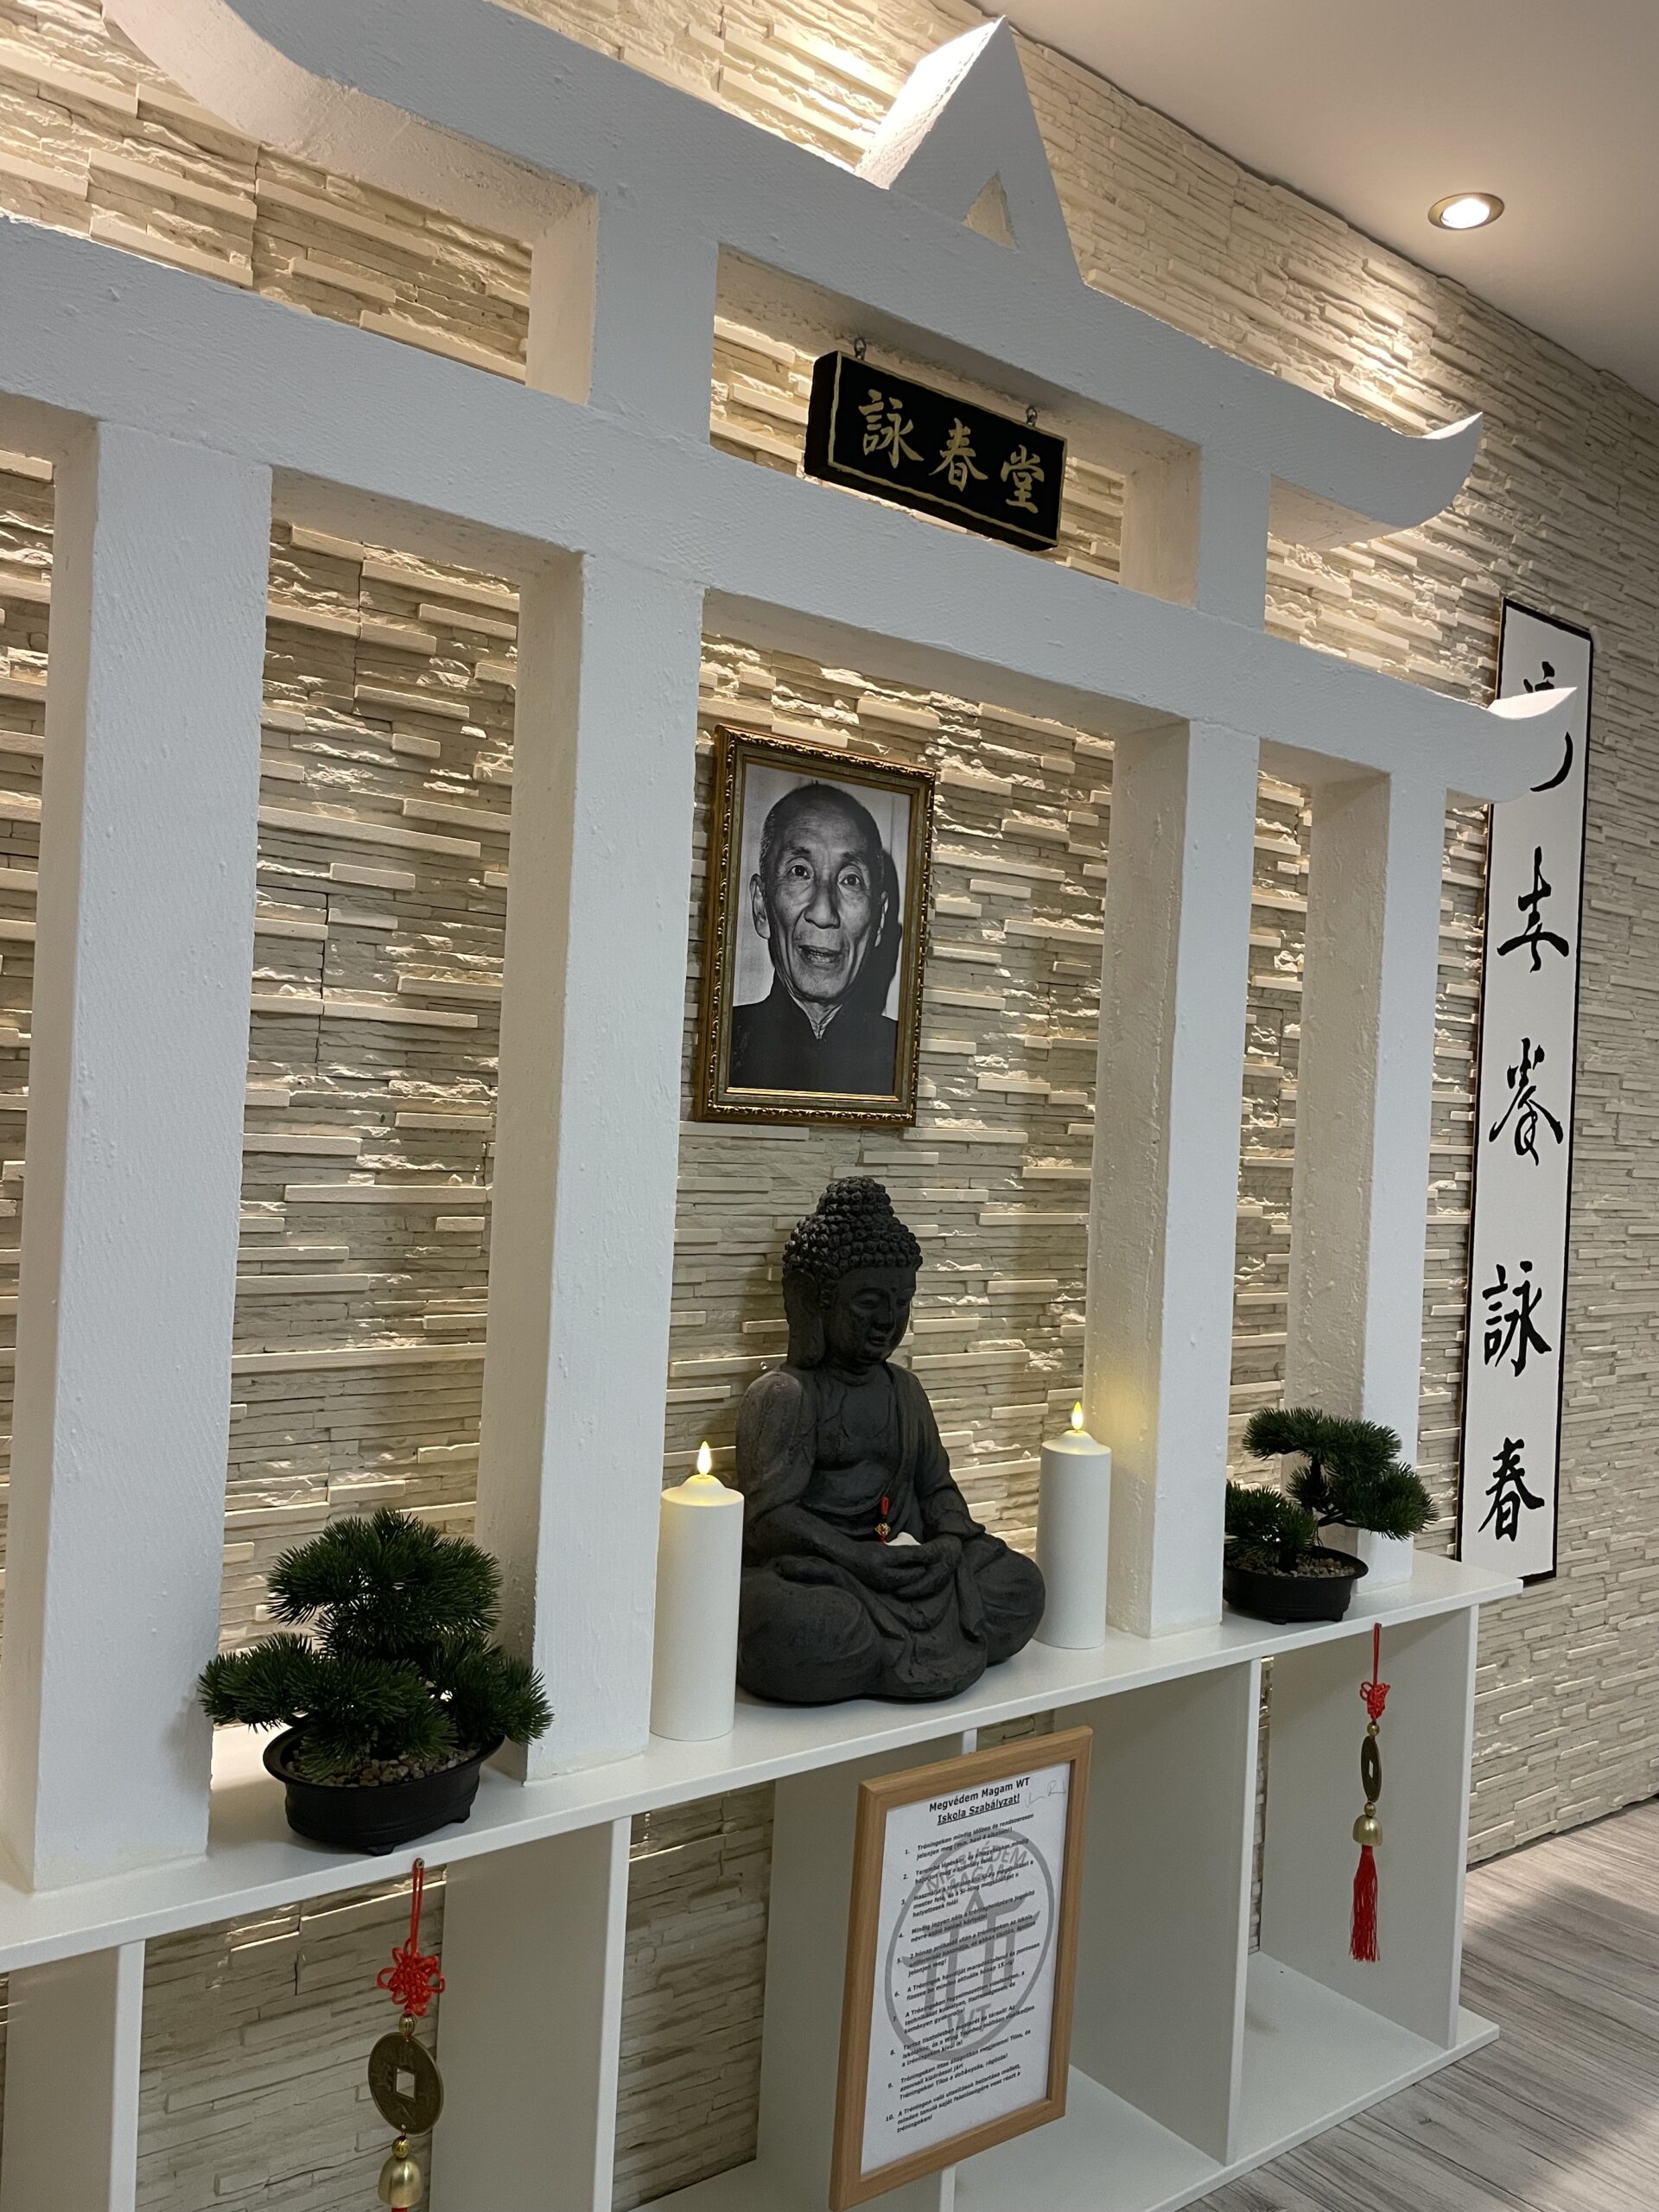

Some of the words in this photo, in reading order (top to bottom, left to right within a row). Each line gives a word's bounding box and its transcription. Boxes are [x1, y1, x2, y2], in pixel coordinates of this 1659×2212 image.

[858, 389, 1045, 513] 詠春堂
[929, 1793, 978, 1811] Megvédem
[981, 1783, 1013, 1797] Magam
[1015, 1777, 1029, 1787] WT
[938, 1808, 965, 1824] Iskola
[969, 1793, 1020, 1815] Szabályzat!
